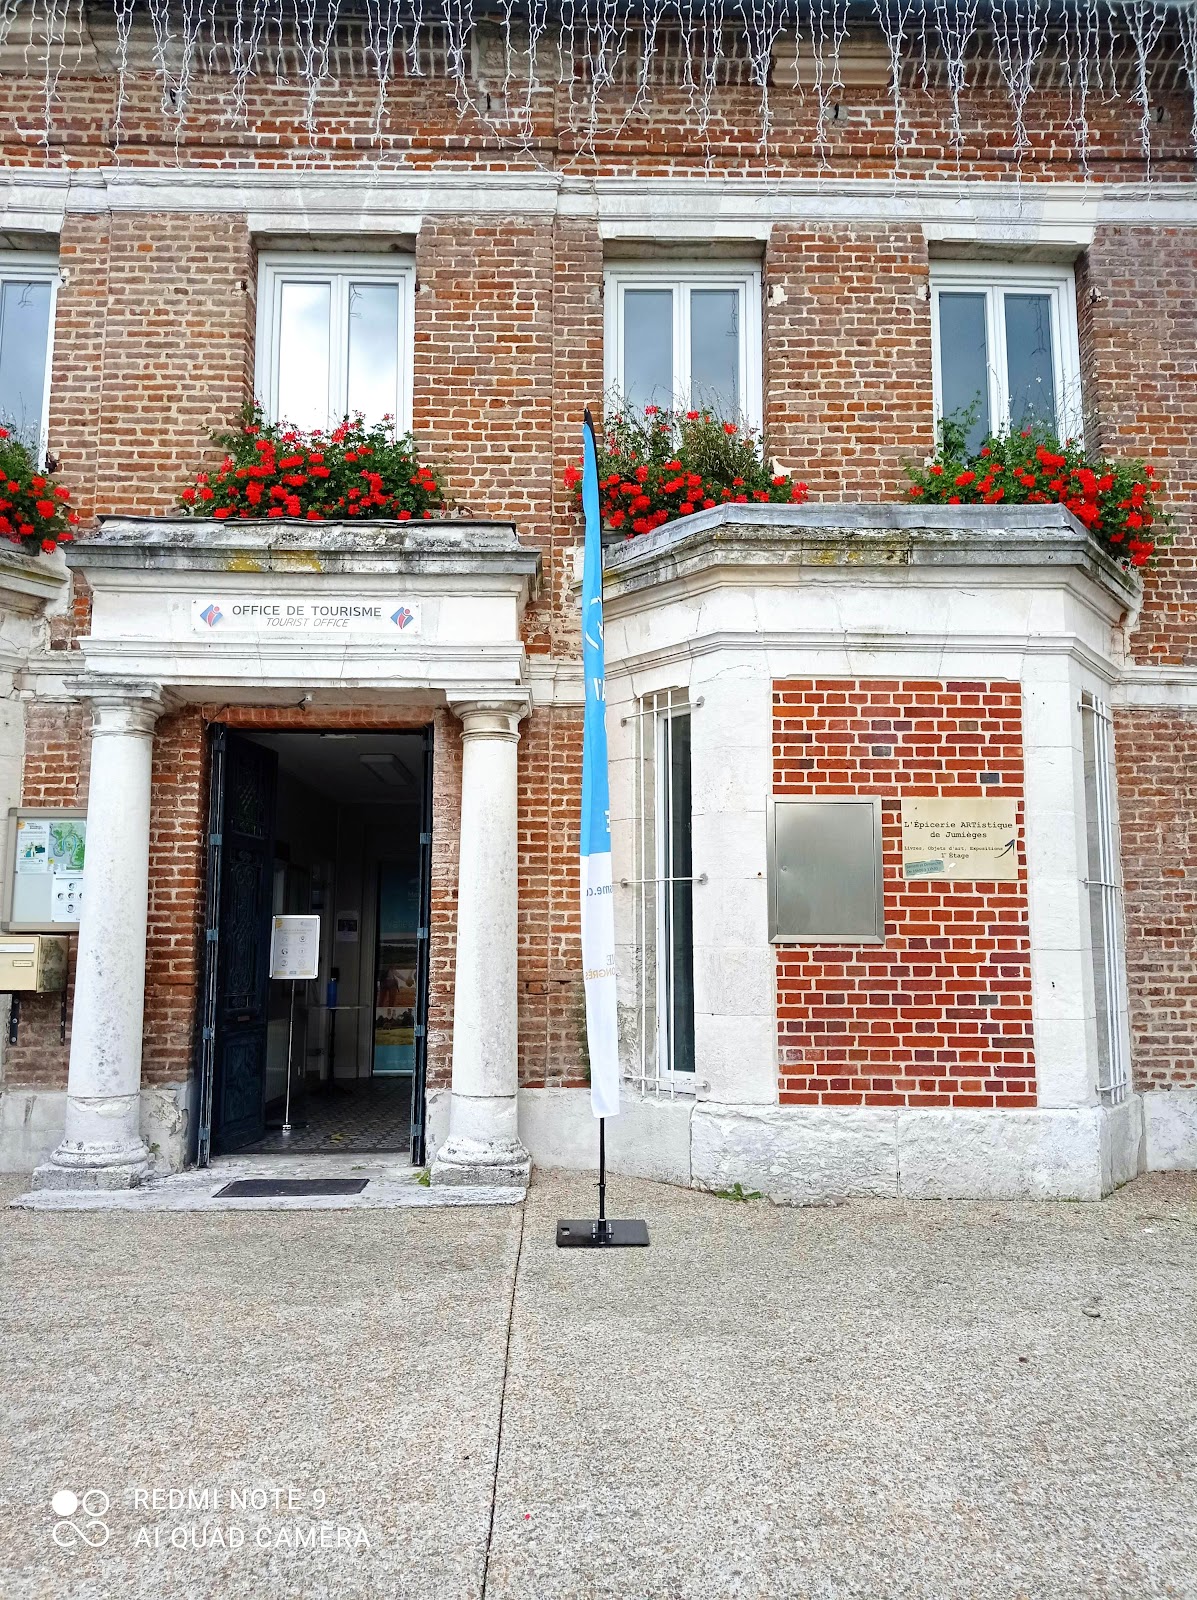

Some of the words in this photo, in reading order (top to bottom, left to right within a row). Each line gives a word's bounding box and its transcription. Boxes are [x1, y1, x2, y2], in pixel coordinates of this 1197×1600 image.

[232, 605, 280, 616] OFFICE
[286, 605, 304, 616] DE
[310, 605, 382, 617] TOURISME
[266, 617, 310, 627] TOURIST
[313, 618, 350, 628] OFFICE
[904, 820, 956, 830] L'Épicerie
[960, 821, 1013, 830] ARTistique
[945, 831, 987, 840] Jumièges
